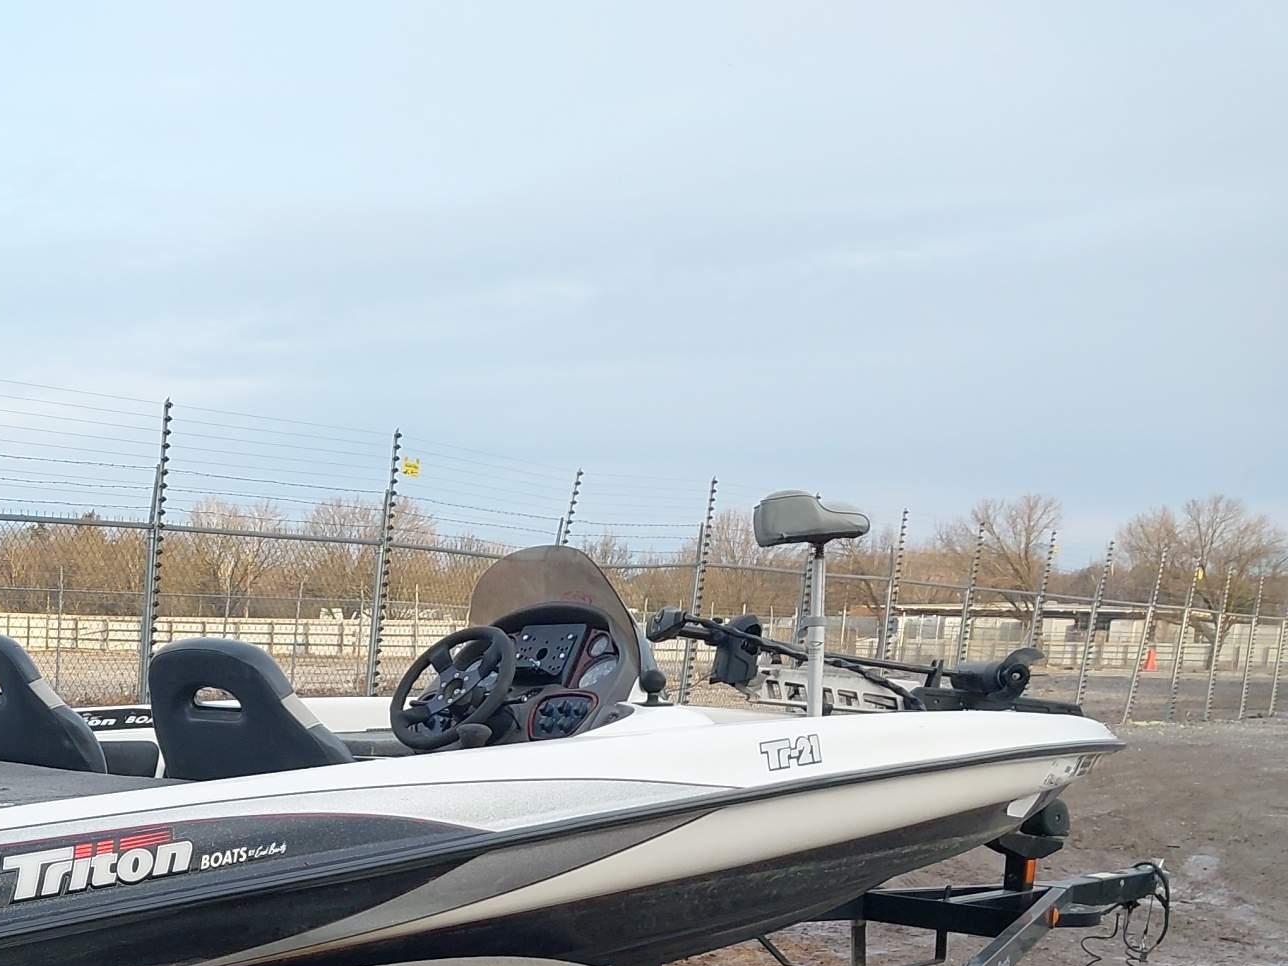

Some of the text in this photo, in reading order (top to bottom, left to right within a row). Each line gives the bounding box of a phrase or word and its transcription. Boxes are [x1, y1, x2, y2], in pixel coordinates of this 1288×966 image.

[759, 734, 822, 772] Tr-21
[2, 836, 194, 902] Triton
[200, 846, 247, 870] BOATS
